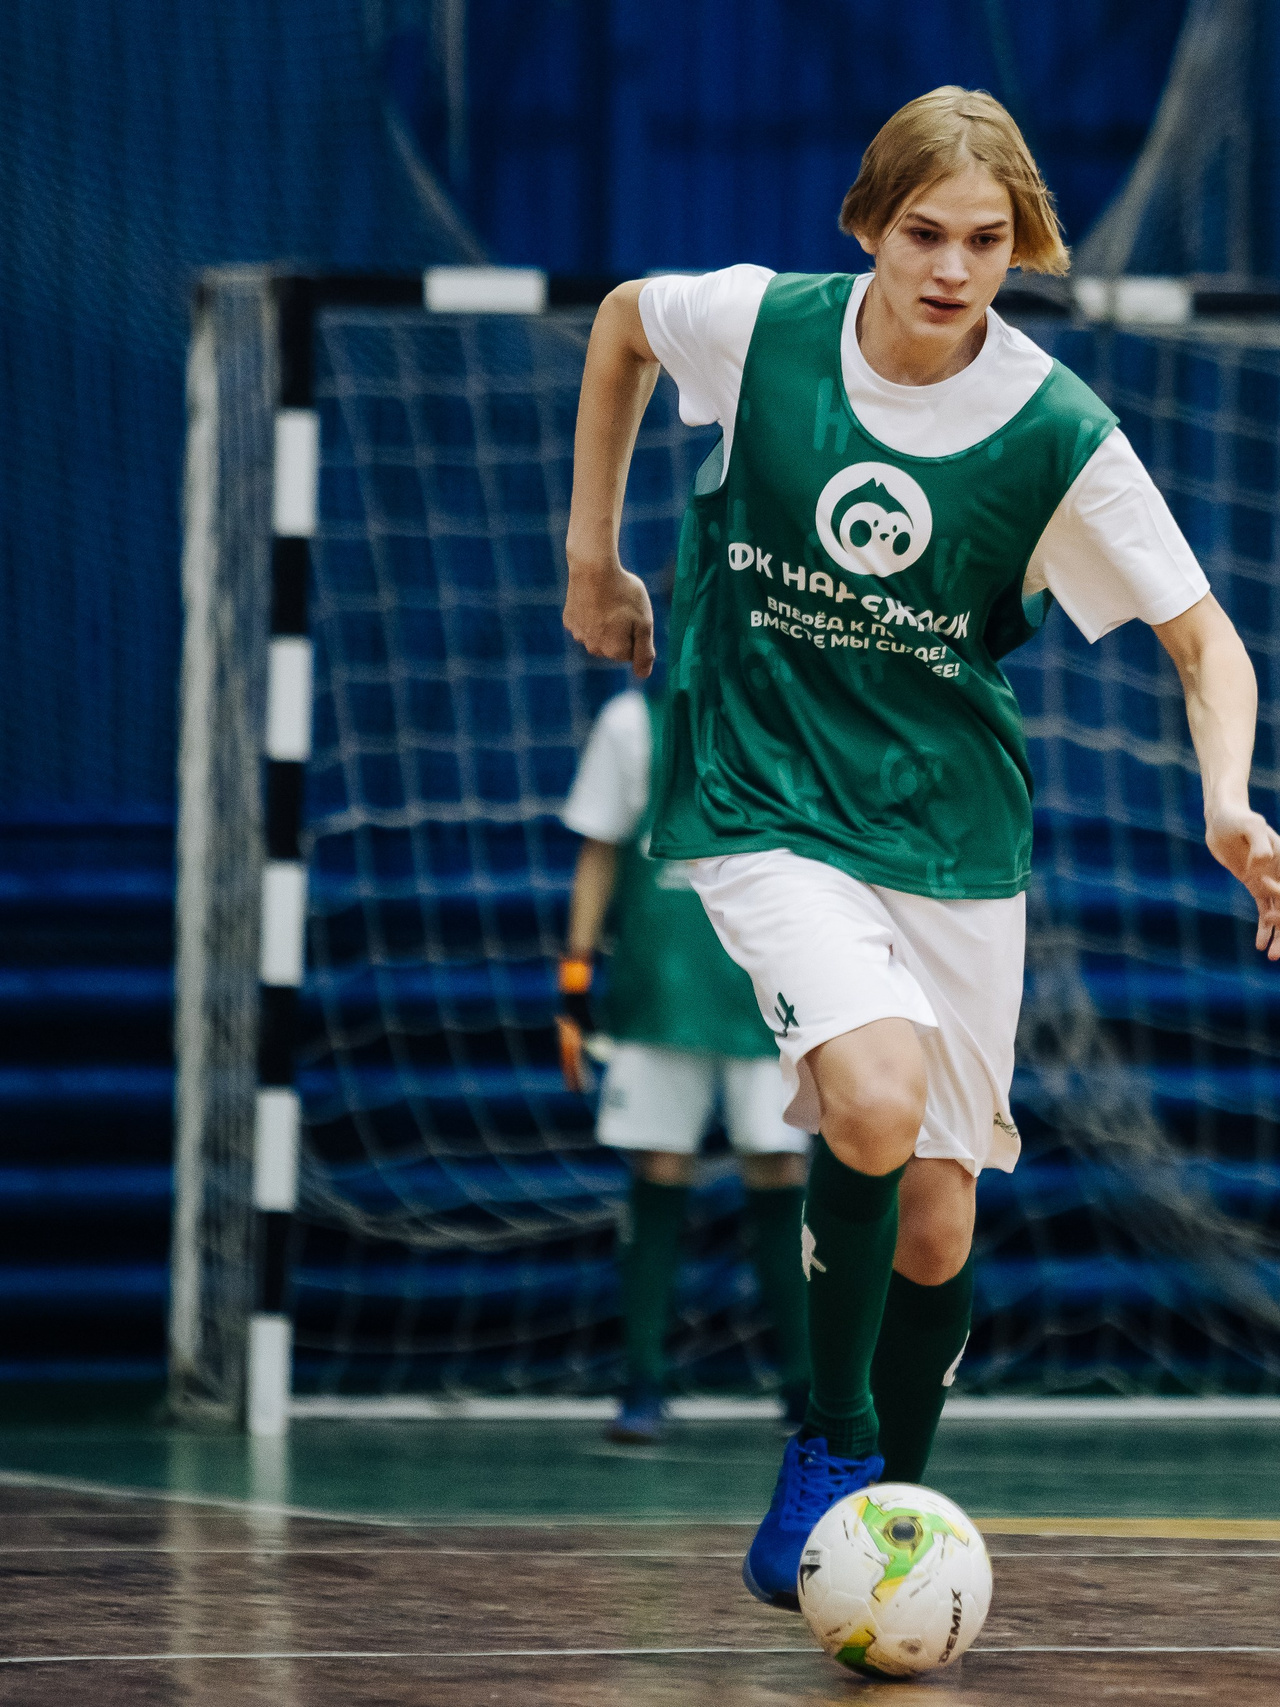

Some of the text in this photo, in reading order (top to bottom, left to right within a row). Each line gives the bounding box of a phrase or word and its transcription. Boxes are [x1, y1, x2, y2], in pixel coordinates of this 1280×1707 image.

[728, 542, 774, 579] ФК
[850, 620, 865, 633] К
[830, 634, 870, 650] МЫ
[938, 1587, 962, 1664] DEMIX
